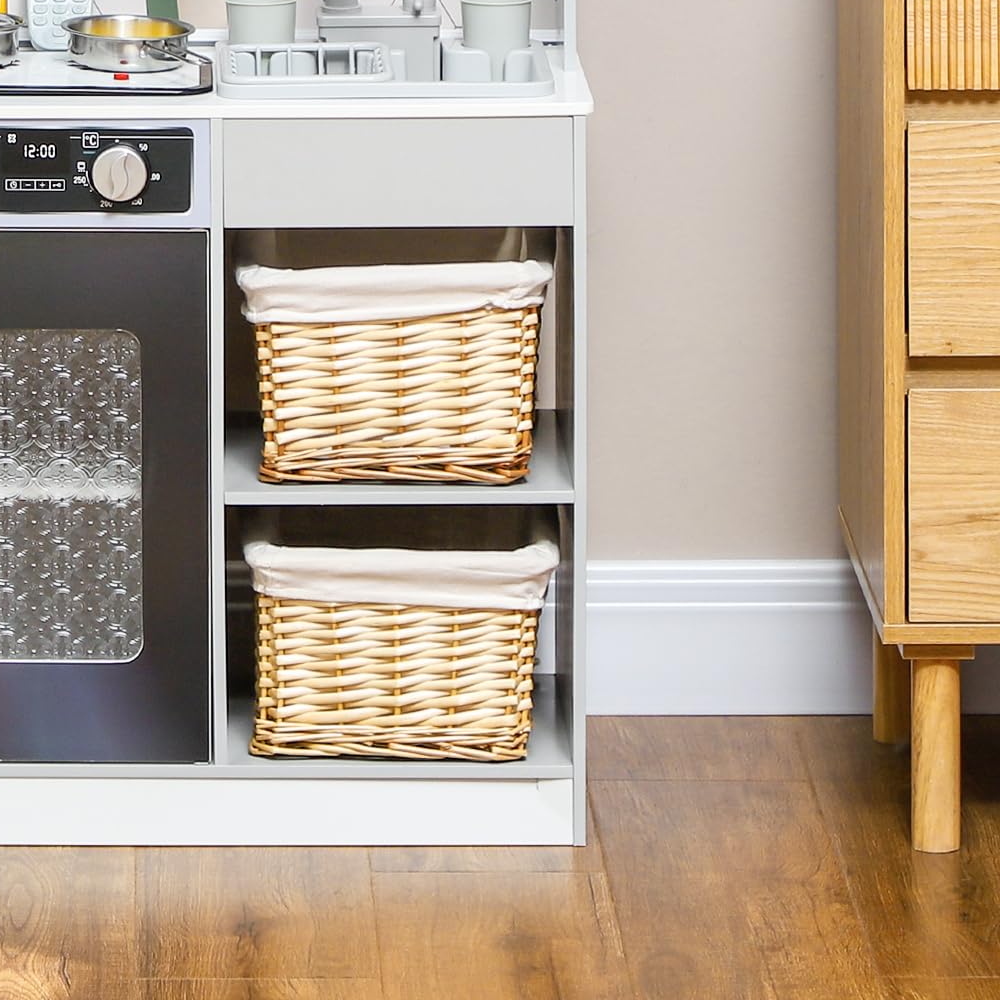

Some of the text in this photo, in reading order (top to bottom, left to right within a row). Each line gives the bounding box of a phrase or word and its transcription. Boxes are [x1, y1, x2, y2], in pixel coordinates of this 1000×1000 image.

[23, 144, 56, 158] 12:00
[138, 143, 149, 152] 50
[73, 175, 87, 185] 250
[150, 172, 161, 181] 00
